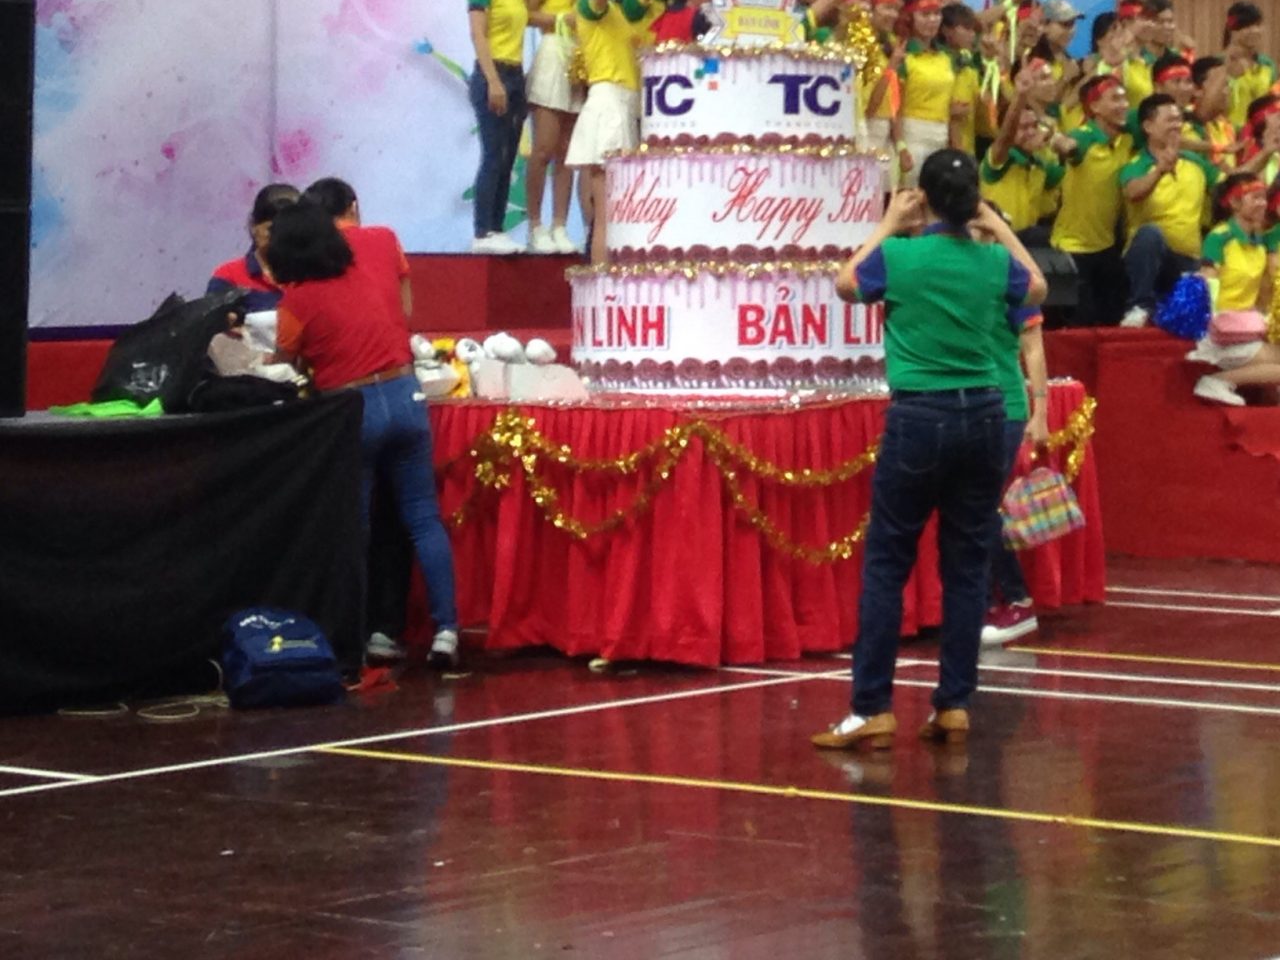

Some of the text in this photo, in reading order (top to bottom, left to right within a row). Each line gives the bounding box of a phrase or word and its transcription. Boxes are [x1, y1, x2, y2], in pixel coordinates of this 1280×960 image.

[767, 73, 841, 116] TC
[711, 166, 825, 244] Happy
[591, 294, 665, 347] LĨNH
[737, 285, 828, 347] BẢN
